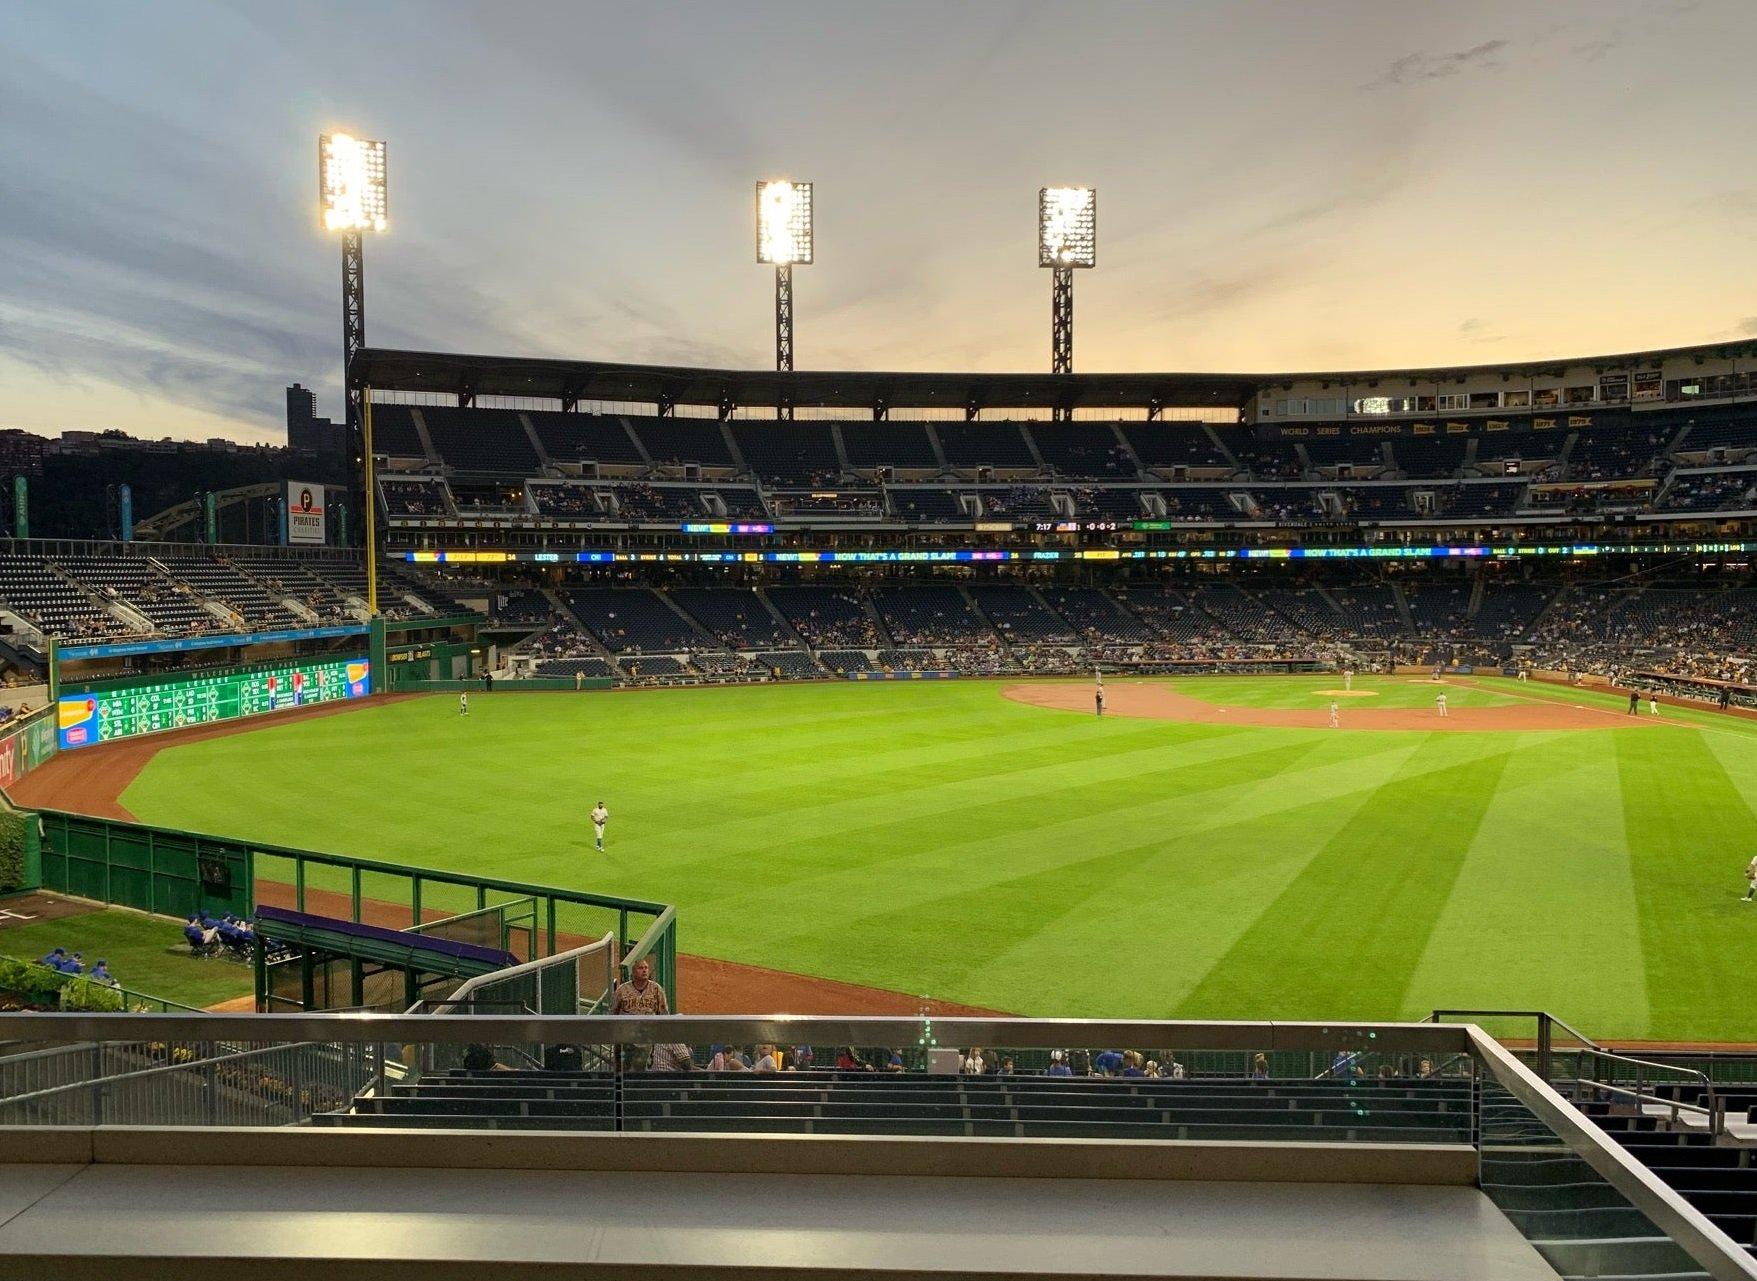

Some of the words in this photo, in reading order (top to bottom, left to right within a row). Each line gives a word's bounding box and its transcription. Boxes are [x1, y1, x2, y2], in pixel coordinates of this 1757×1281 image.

[1280, 427, 1309, 436] WORLD
[1316, 427, 1340, 435] SERIES
[1350, 425, 1401, 435] CHAMPIONS
[293, 516, 320, 527] PIRATES
[1036, 523, 1052, 531] 7:17
[534, 553, 559, 561] LESTER
[1305, 549, 1326, 557] NOW
[1327, 549, 1358, 557] THAT'S
[192, 668, 236, 679] WELCOME
[250, 667, 300, 679] AMERICAN
[306, 662, 339, 672] LEAGUE
[111, 683, 176, 698] NATIONAL
[186, 676, 228, 688] LEAGUE
